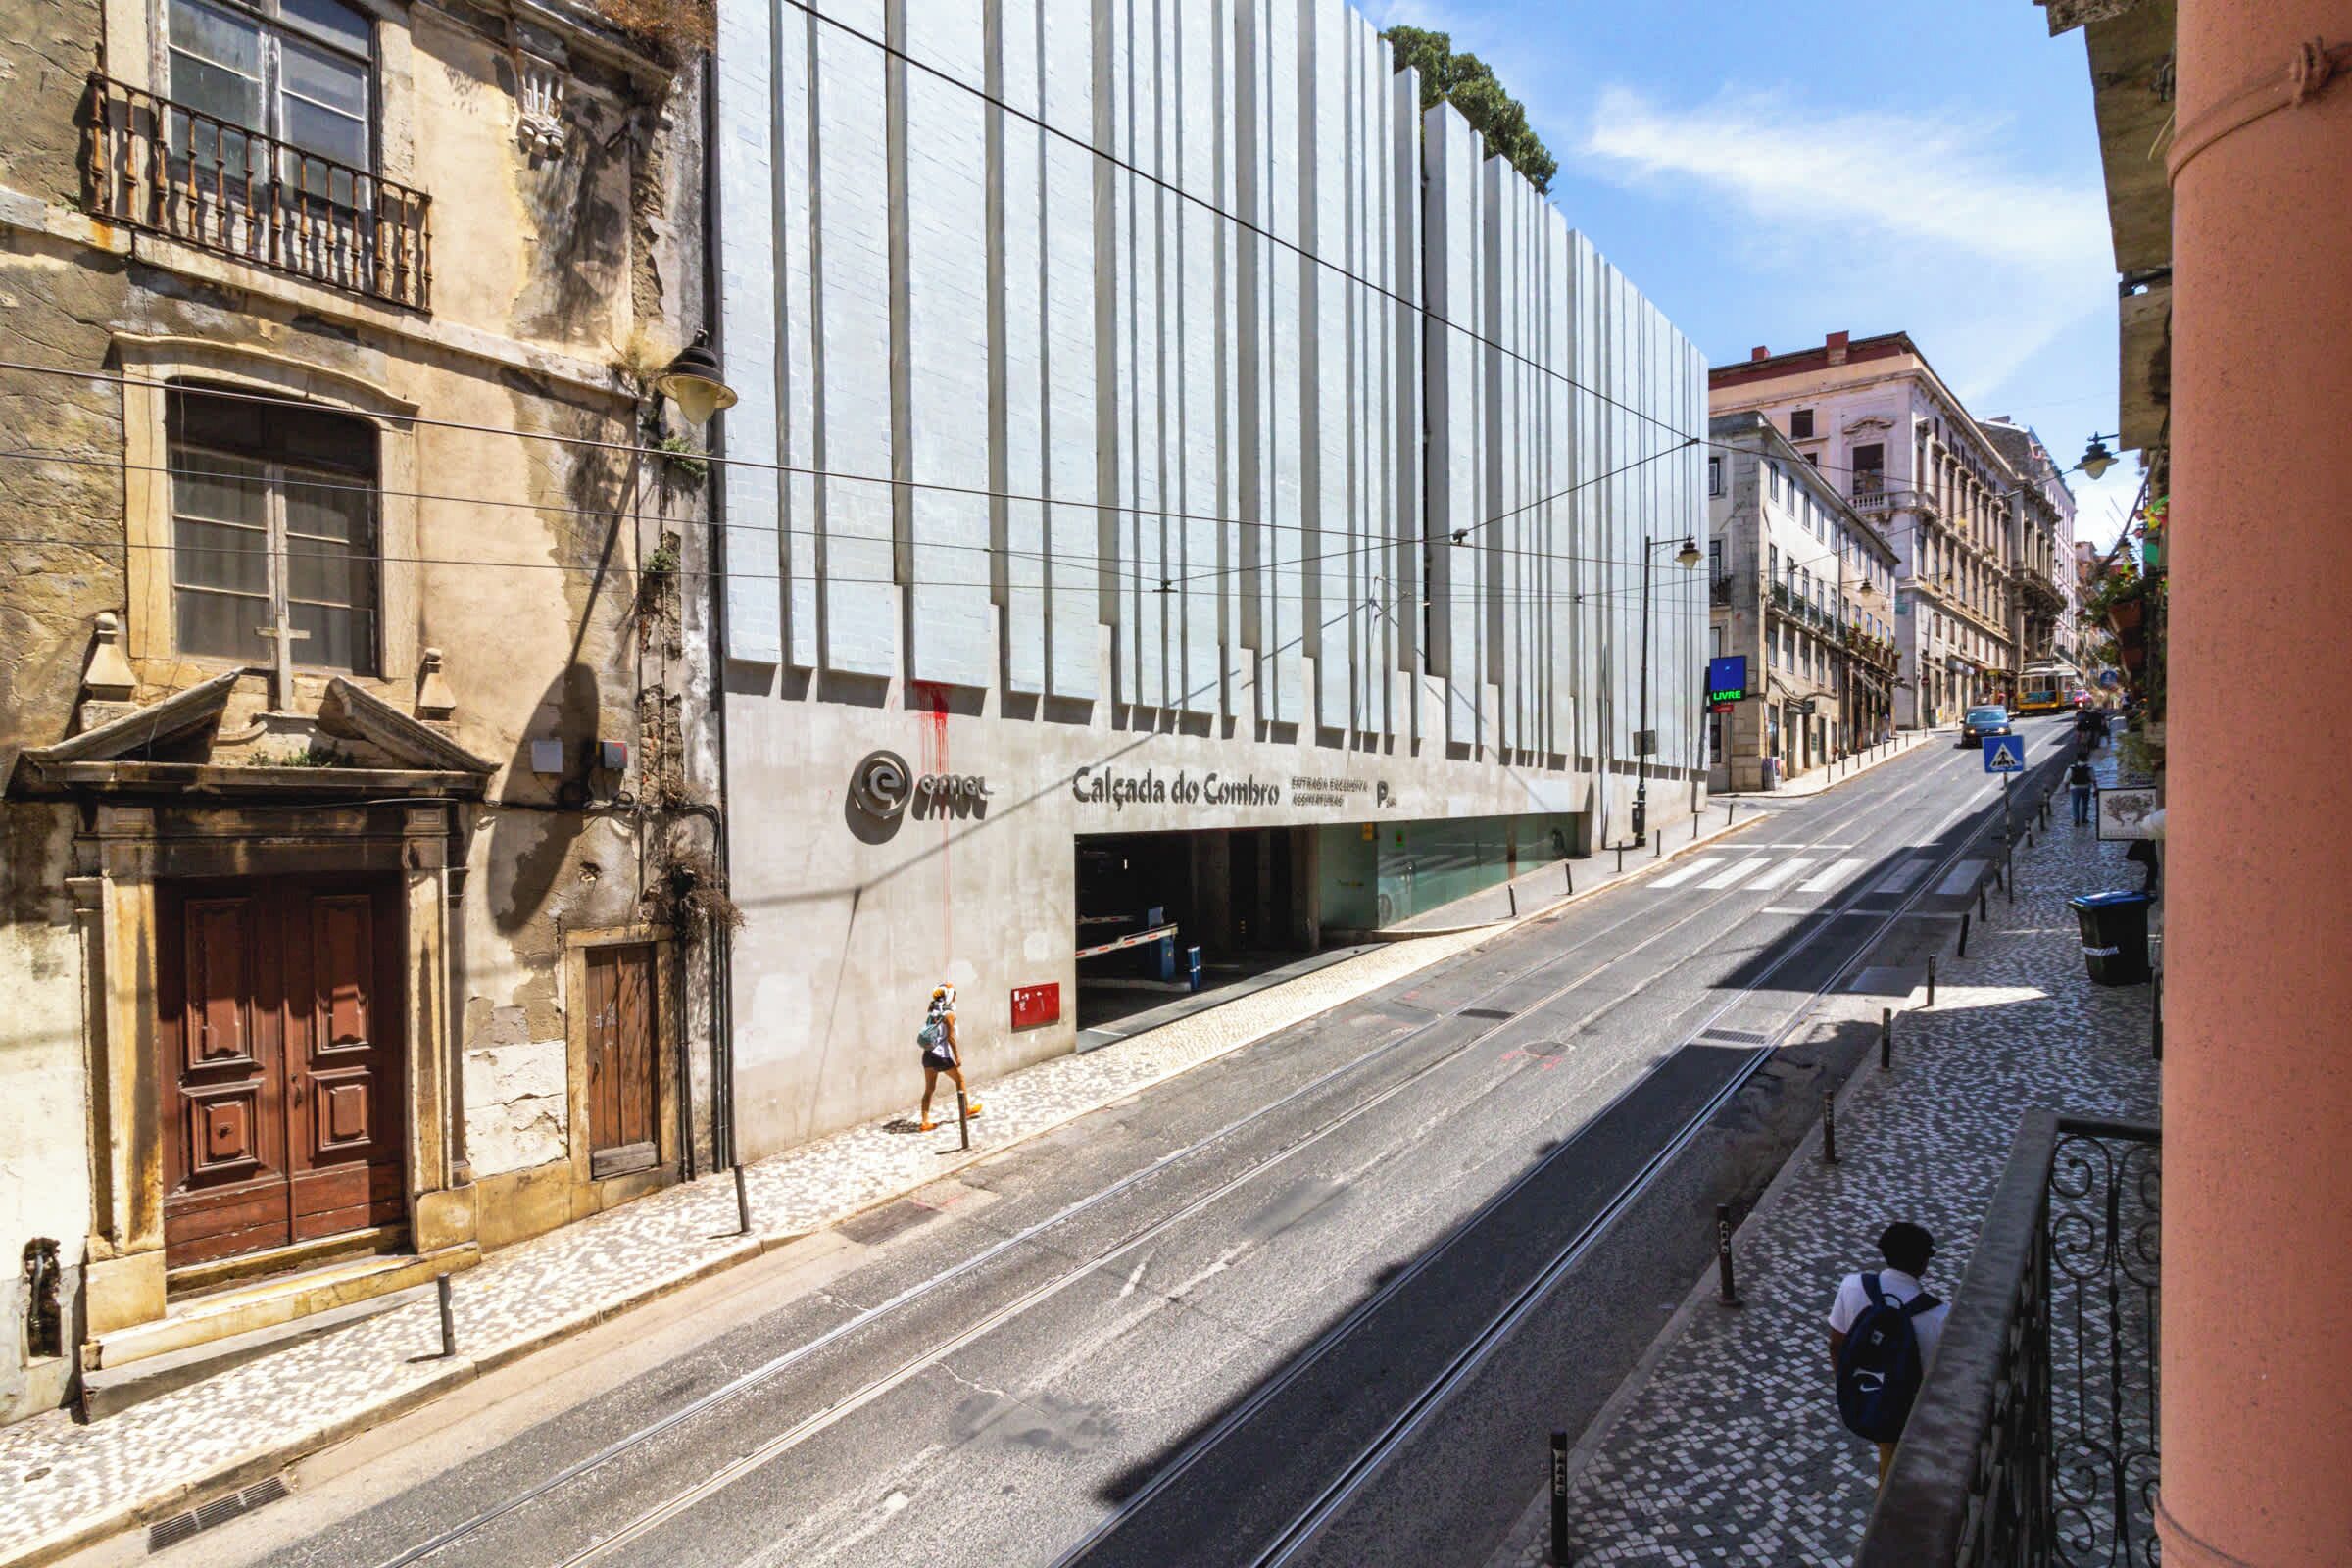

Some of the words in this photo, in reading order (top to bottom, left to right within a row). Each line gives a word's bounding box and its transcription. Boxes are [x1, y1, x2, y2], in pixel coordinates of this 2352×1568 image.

[1713, 690, 1741, 701] LIVRE
[1072, 766, 1166, 811] Calçada
[1170, 770, 1200, 804] do
[1203, 772, 1280, 806] Combro
[1377, 780, 1389, 808] P
